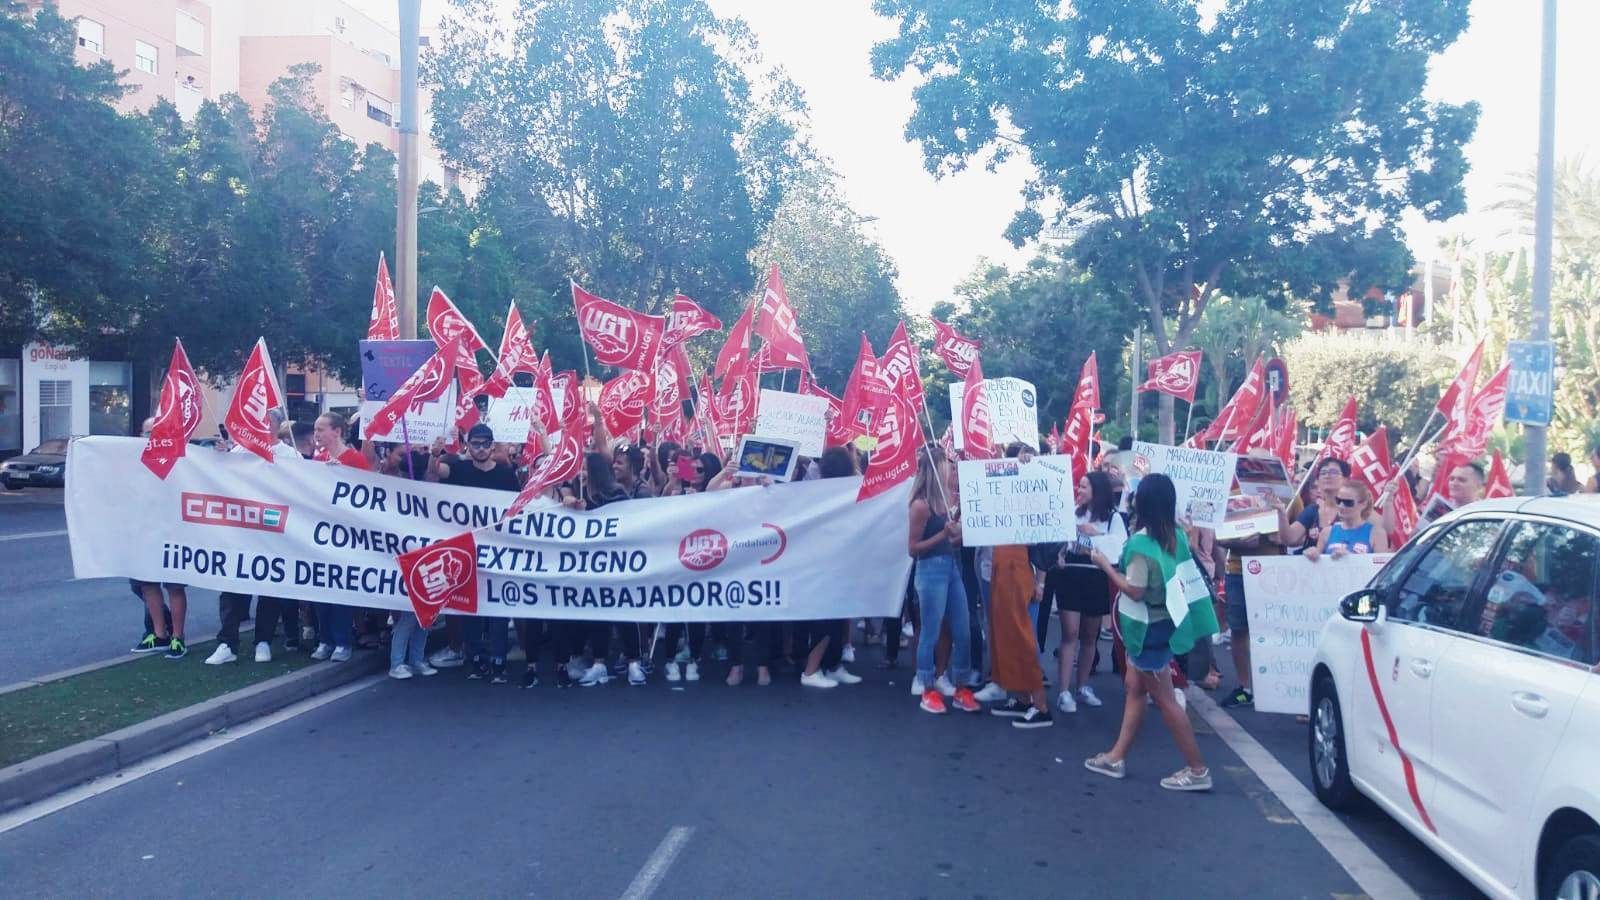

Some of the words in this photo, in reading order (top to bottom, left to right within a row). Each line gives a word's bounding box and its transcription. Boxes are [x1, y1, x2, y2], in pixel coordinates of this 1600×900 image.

[585, 307, 632, 343] UGT
[1510, 370, 1548, 395] TAXI
[1166, 449, 1226, 466] MARGINADOS
[861, 460, 910, 488] www.ugt.es
[986, 481, 1002, 495] TE
[1011, 479, 1048, 494] ROBAN
[967, 499, 982, 513] TE
[1049, 494, 1064, 511] ES
[1189, 486, 1224, 502] SOMOS
[186, 498, 260, 525] CCOO
[332, 481, 387, 514] POR
[396, 491, 430, 519] UN
[437, 501, 576, 539] CONVENIO
[585, 517, 619, 539] DE
[966, 515, 991, 529] QUE
[995, 515, 1012, 528] NO
[313, 521, 446, 556] COMERC
[476, 545, 549, 573] EXTIL
[558, 550, 648, 574] DIGNO
[684, 534, 726, 555] UGT
[236, 554, 286, 584] LOS
[294, 560, 409, 599] DERECH
[487, 580, 539, 607] L@S
[545, 580, 782, 610] TRABAJADOR@S!!
[418, 560, 448, 600] UGT
